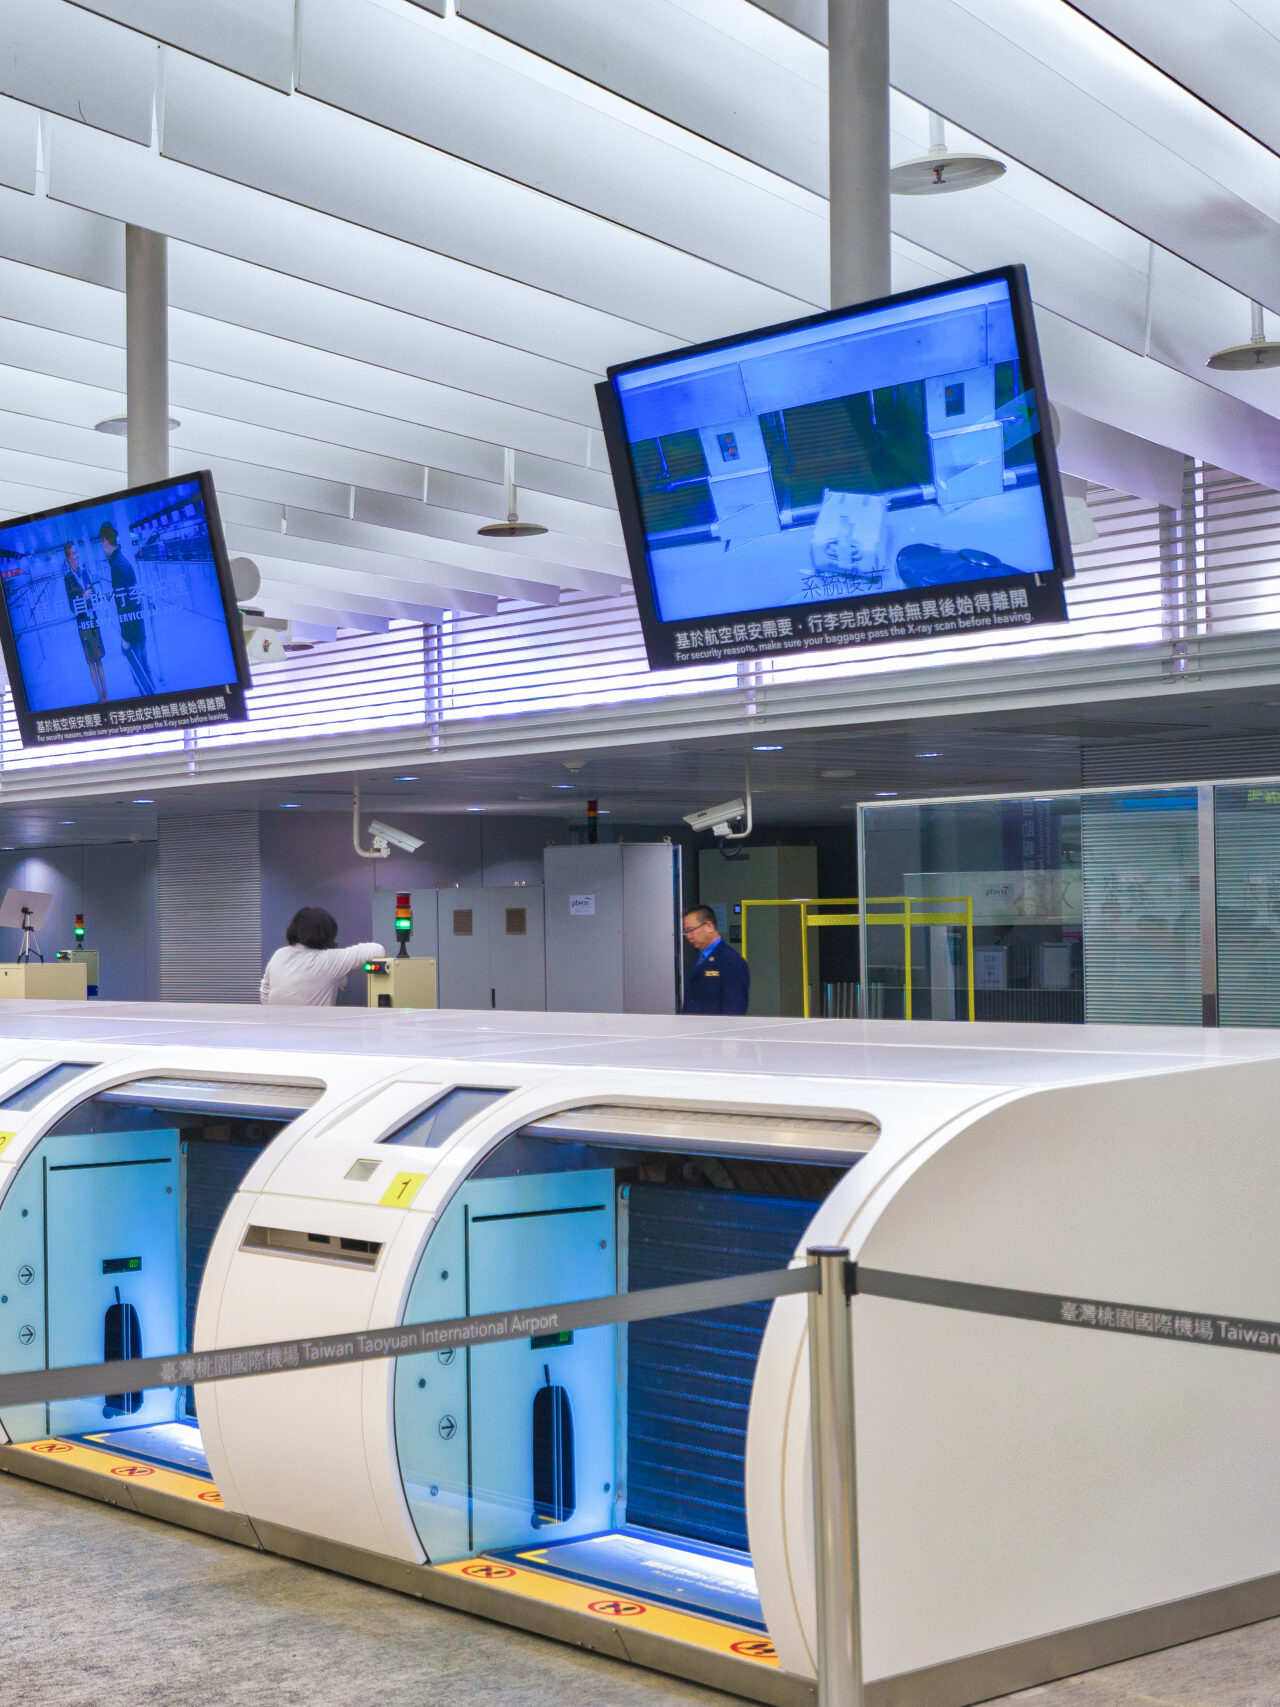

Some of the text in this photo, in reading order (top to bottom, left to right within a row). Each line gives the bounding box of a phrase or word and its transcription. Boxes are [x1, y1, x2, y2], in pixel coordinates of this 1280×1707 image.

[676, 610, 1035, 662] For security reasons, make sure your baggage pass the X-ray scan before leaving.
[397, 1178, 412, 1200] 1
[1060, 1301, 1213, 1341] 臺灣桃園國際機場
[160, 1312, 559, 1385] 臺灣桃園國際機場 Taiwan Taoyuan International Airport
